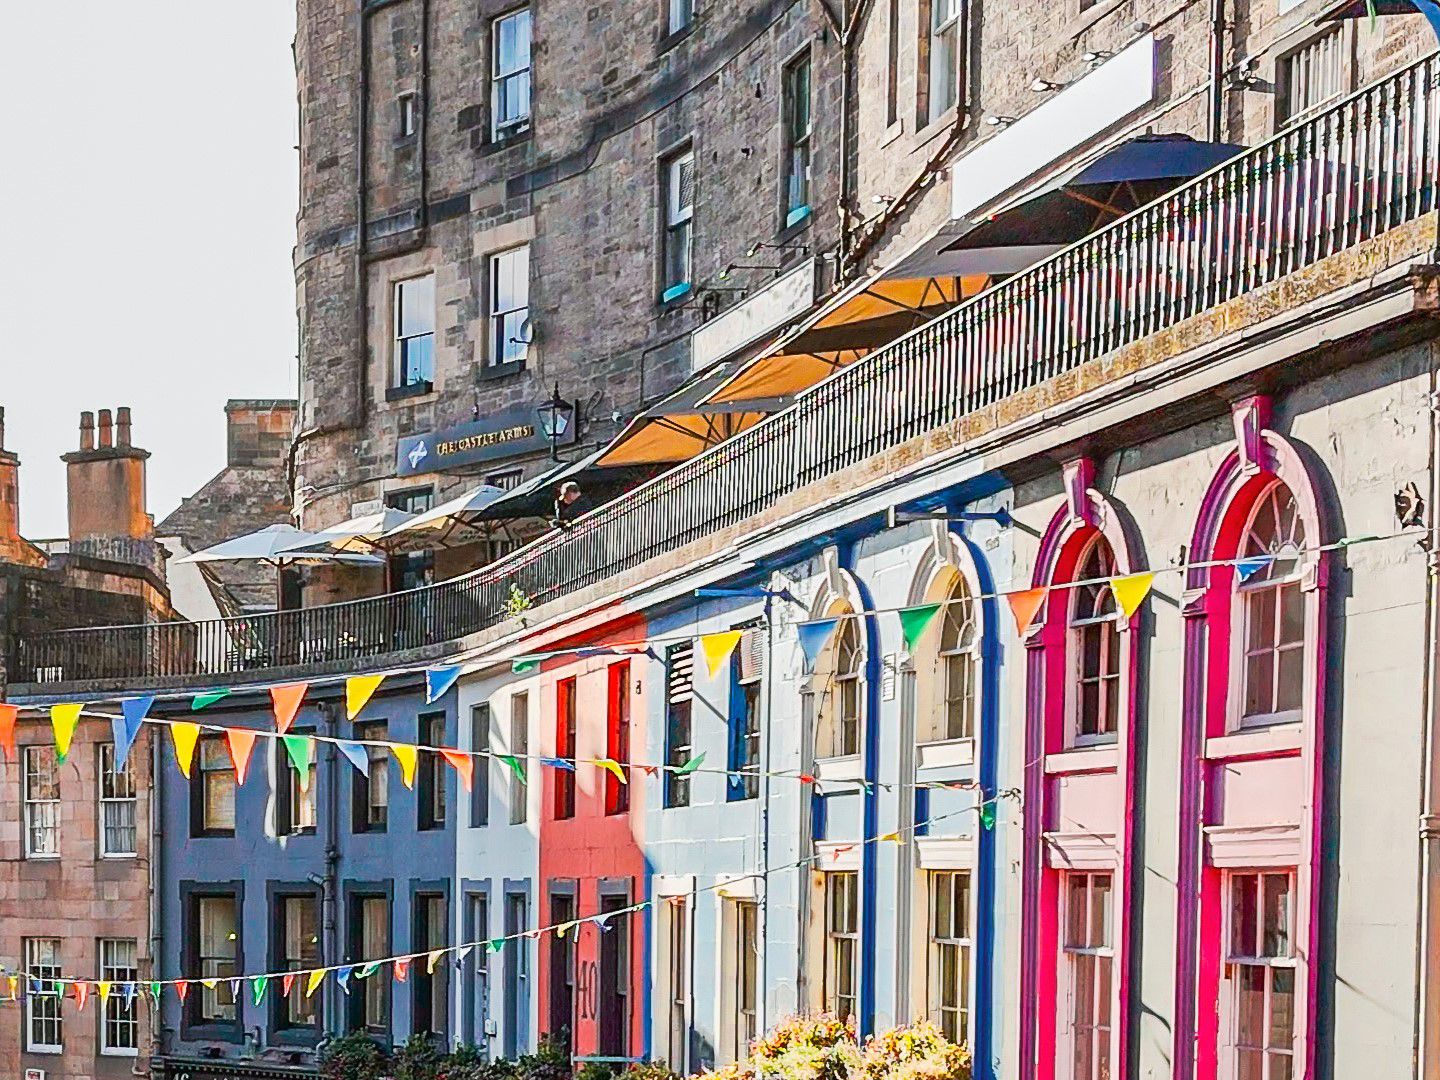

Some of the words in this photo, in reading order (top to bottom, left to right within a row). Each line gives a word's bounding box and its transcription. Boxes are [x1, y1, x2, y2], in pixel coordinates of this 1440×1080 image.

[436, 442, 458, 456] THE
[458, 433, 497, 451] CASTLE
[498, 426, 532, 442] ARMS
